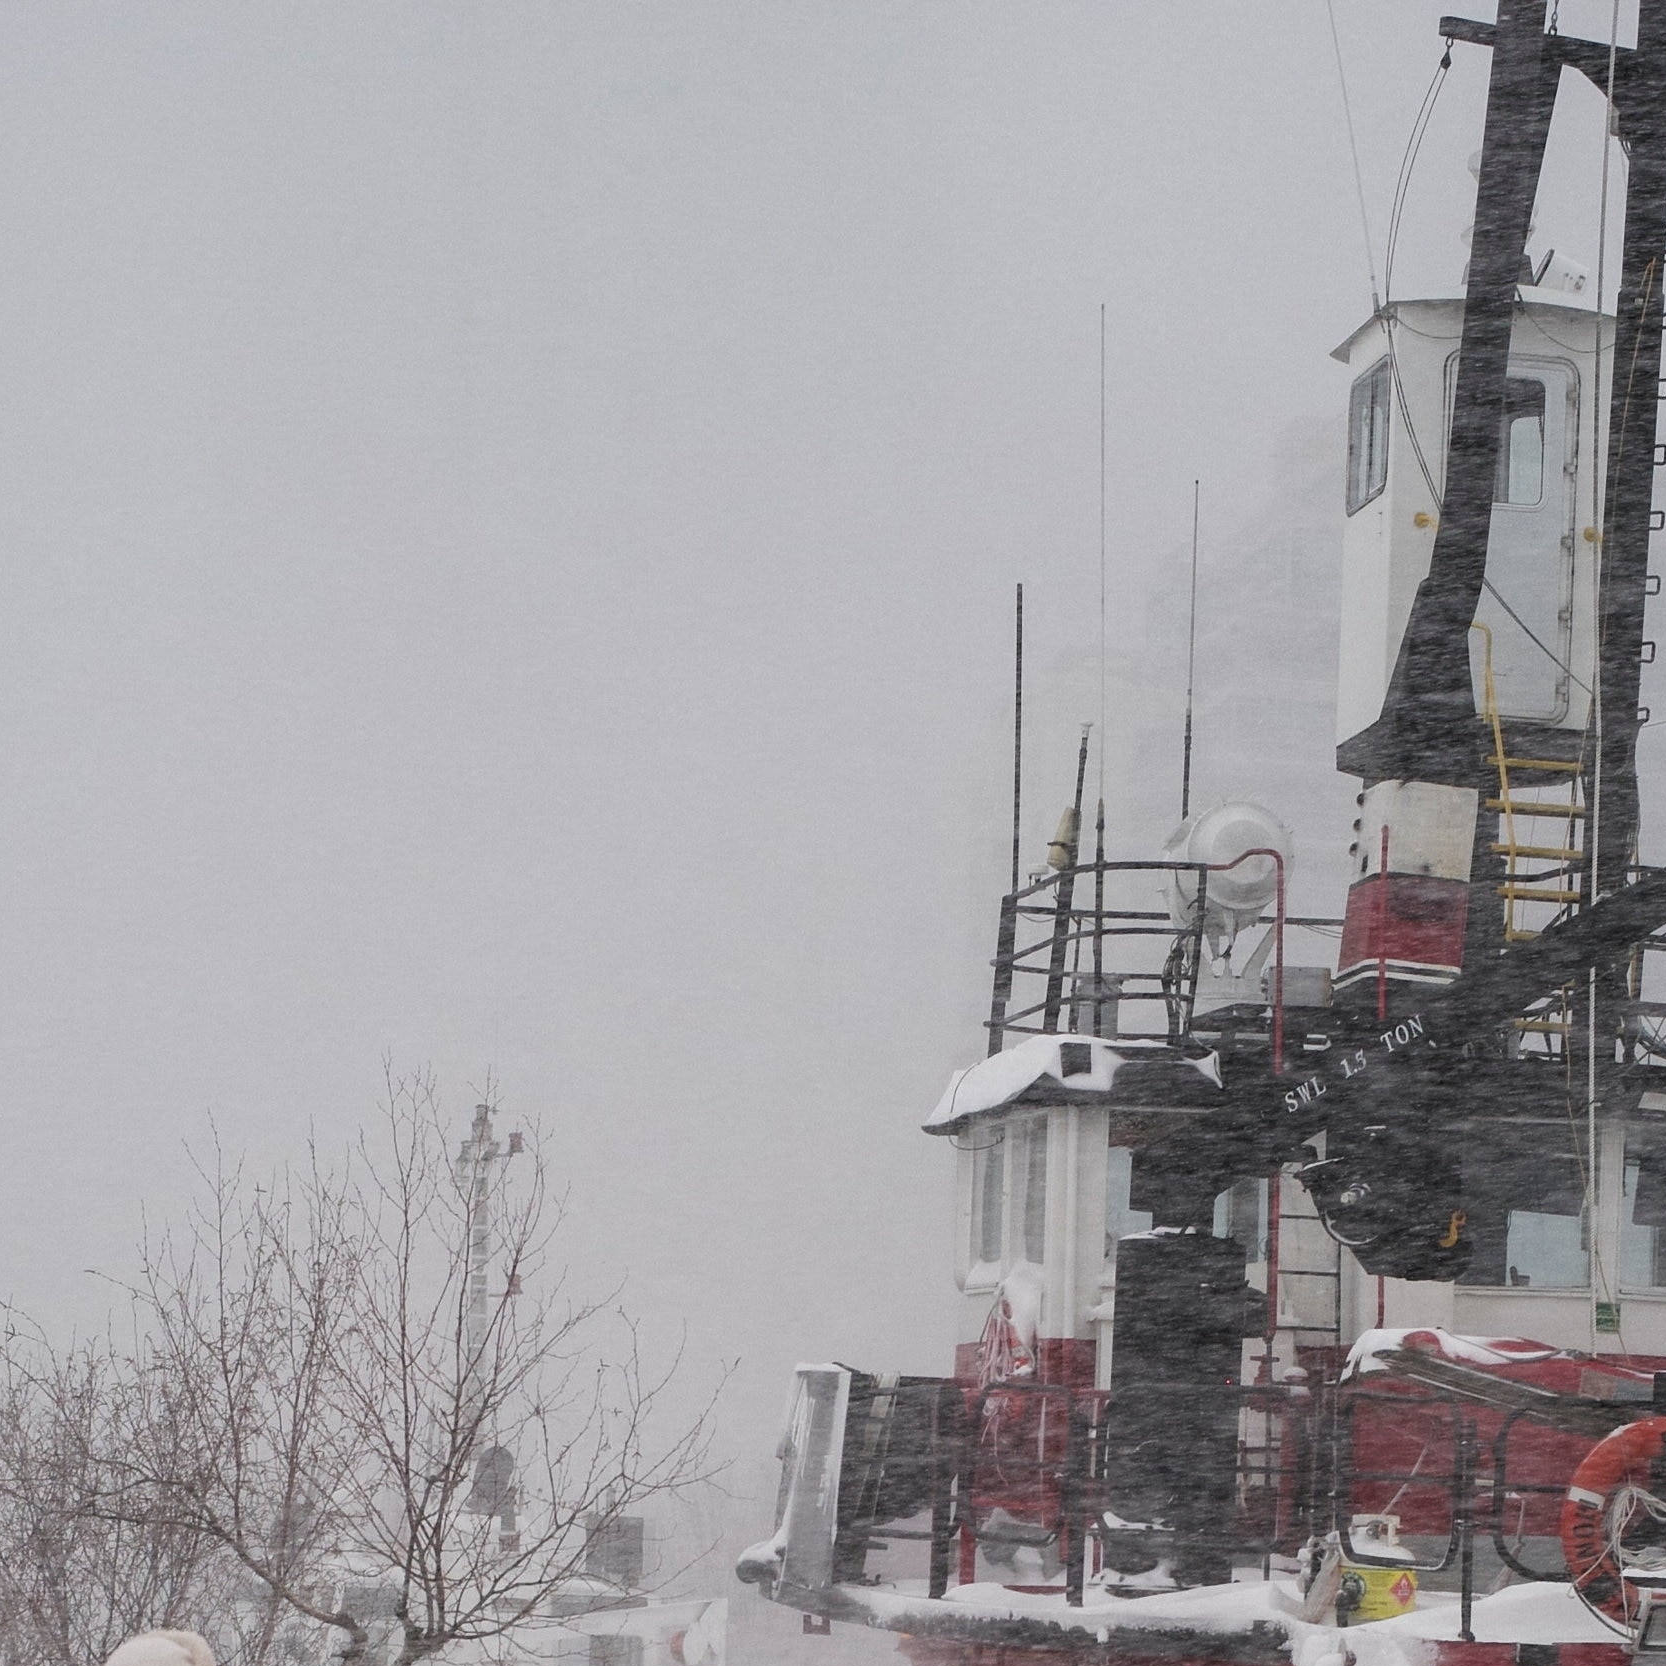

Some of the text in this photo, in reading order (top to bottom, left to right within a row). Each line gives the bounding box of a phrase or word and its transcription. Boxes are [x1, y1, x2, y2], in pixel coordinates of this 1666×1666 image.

[1285, 1014, 1424, 1113] SWL 1.5 TON
